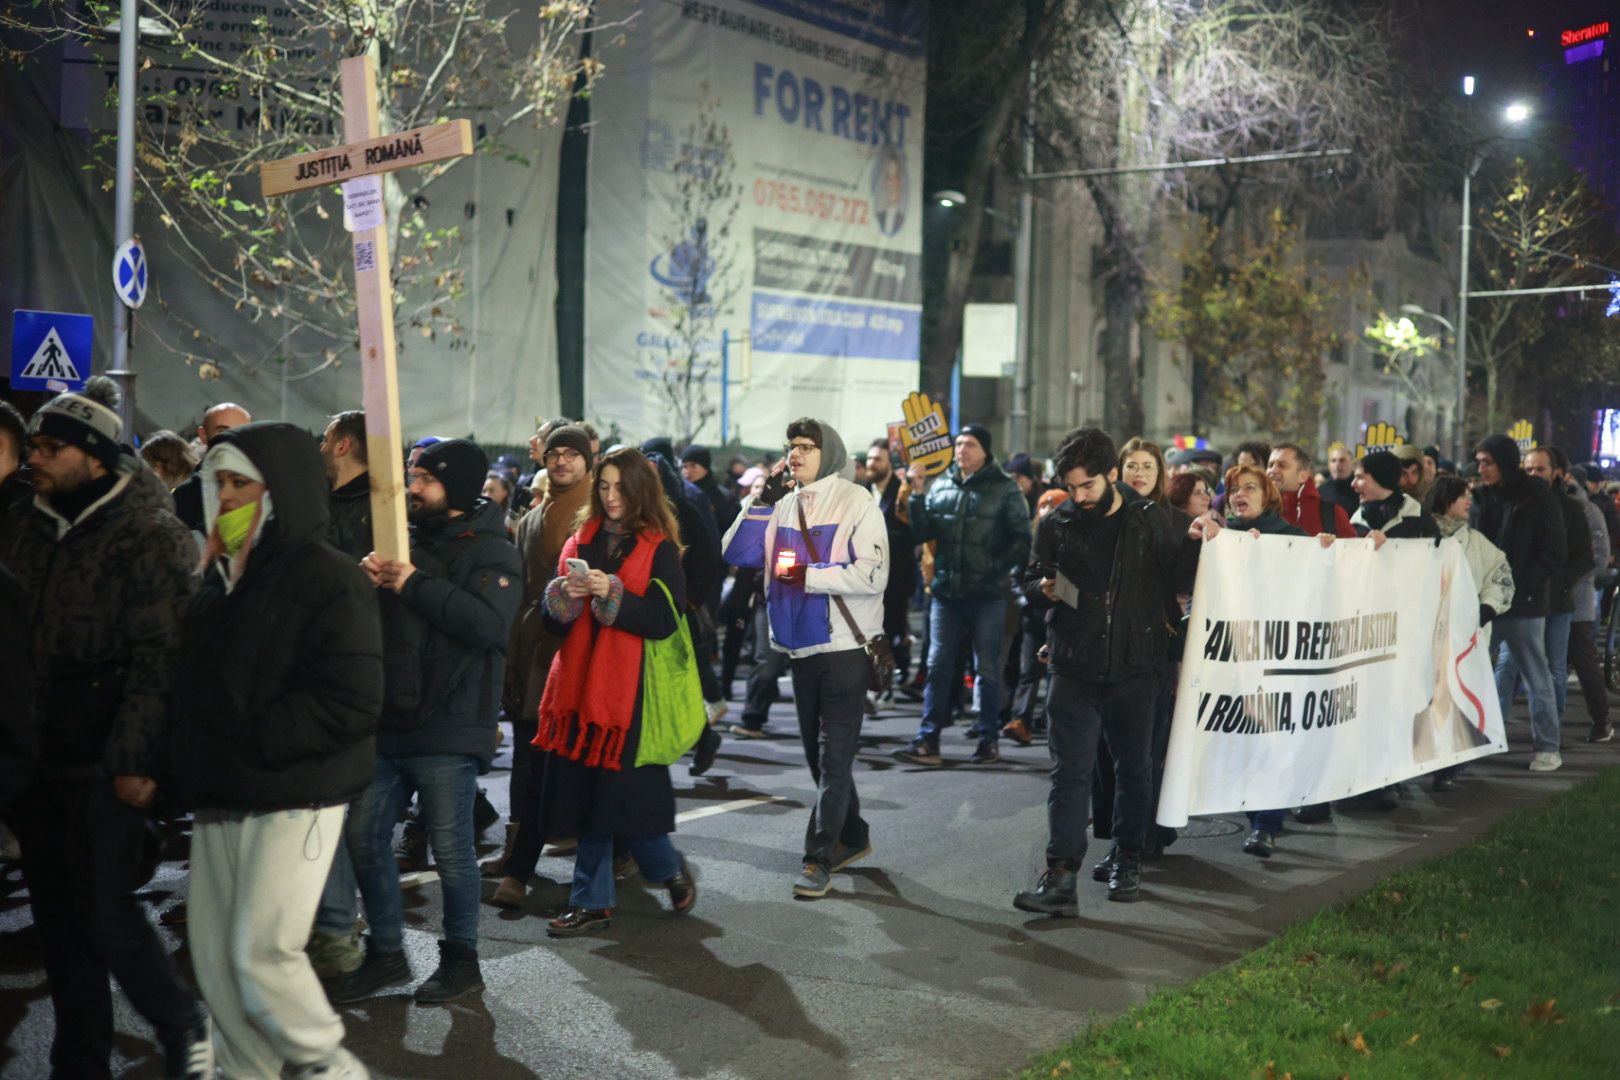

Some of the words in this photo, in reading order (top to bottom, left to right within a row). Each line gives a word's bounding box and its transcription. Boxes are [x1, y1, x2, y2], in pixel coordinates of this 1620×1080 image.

[1561, 21, 1609, 47] Sheraton
[753, 61, 825, 132] FOR
[830, 85, 912, 149] RENT
[365, 133, 424, 166] ROMÂNĂ
[1263, 620, 1290, 660] NU
[1294, 610, 1360, 661] REPREZINTĂ
[1204, 685, 1296, 735] ROMÂNIA,
[1302, 690, 1317, 731] O
[1317, 678, 1358, 729] SUFOCĂ!
